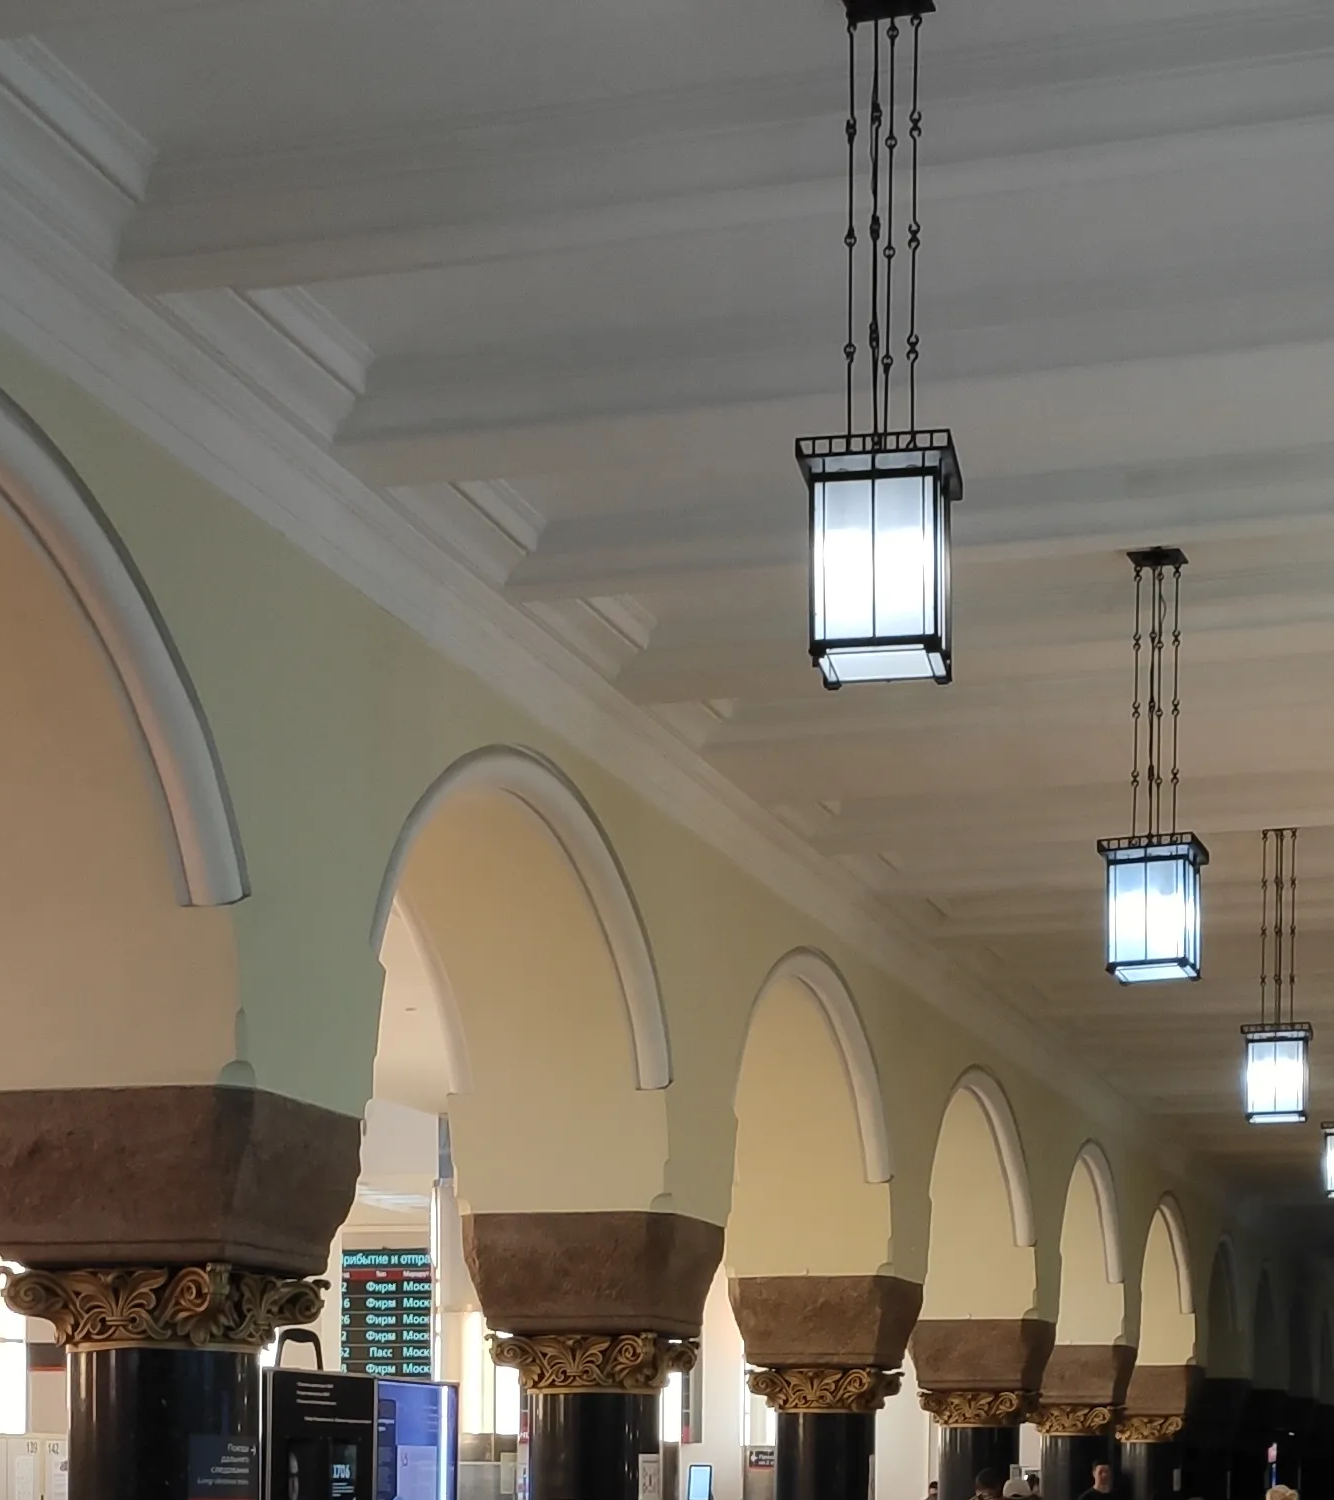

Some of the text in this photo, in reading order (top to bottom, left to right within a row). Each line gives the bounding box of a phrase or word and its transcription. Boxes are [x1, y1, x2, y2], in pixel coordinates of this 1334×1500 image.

[390, 1254, 398, 1265] и
[366, 1281, 397, 1294] Фирм
[366, 1297, 397, 1310] Фирм
[366, 1314, 397, 1327] Фирм
[366, 1331, 397, 1344] Фирм
[369, 1347, 393, 1357] Пасс
[366, 1363, 397, 1376] Фирм
